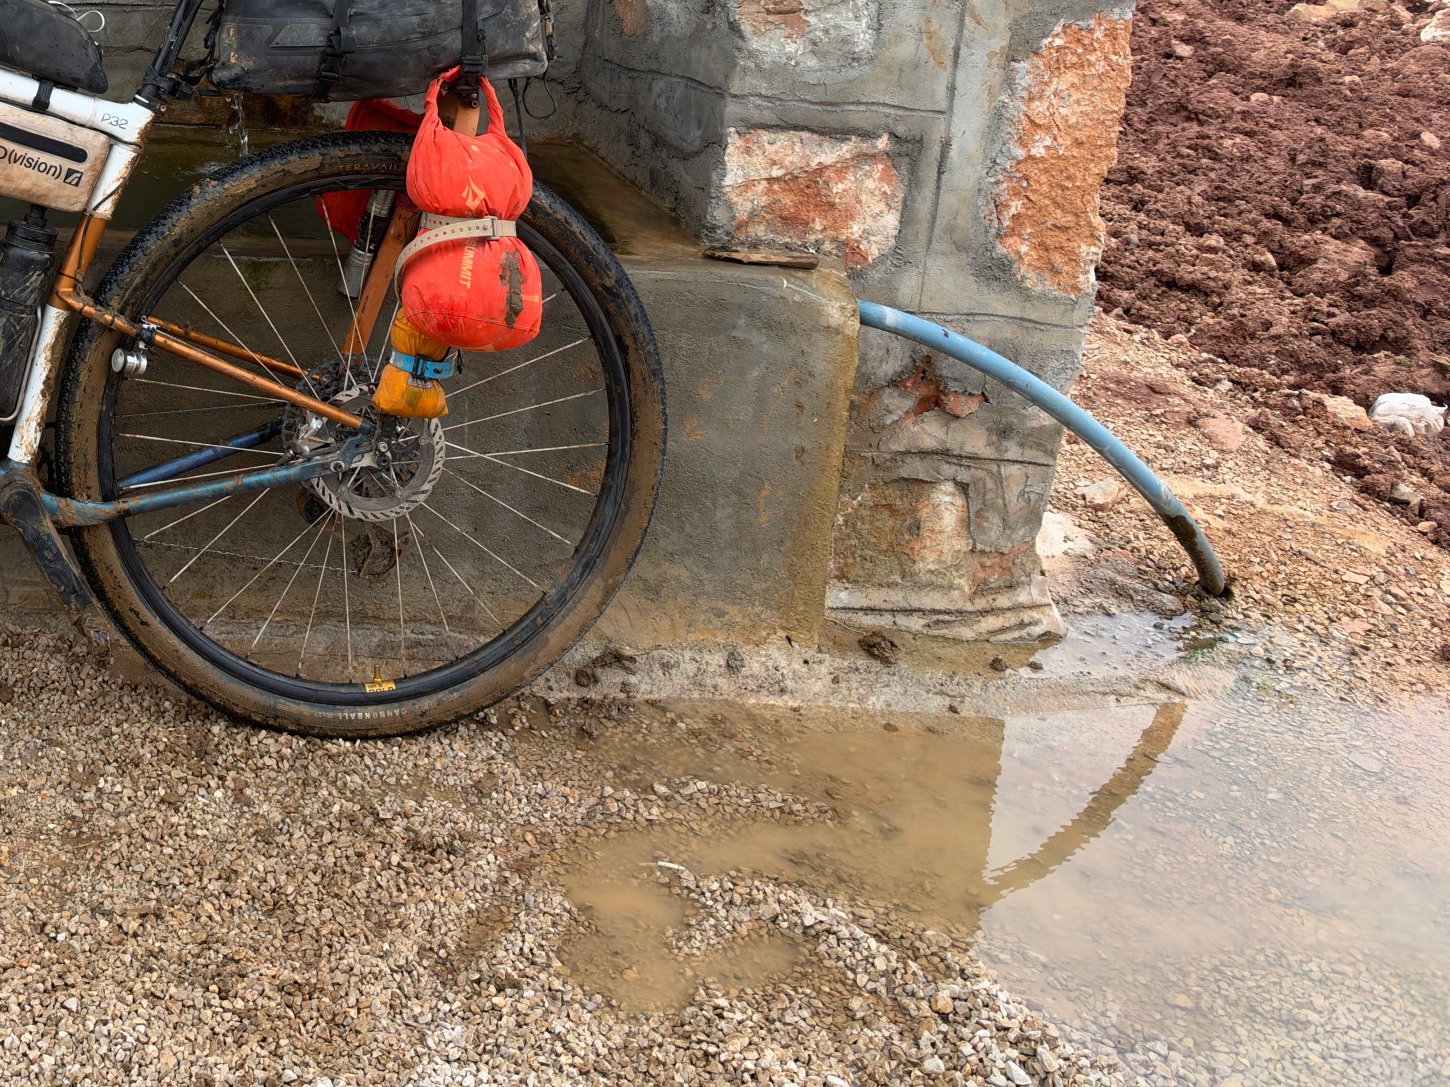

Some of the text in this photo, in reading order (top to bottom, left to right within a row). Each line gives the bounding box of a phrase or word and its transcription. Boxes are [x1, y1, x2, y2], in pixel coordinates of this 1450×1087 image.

[337, 163, 399, 172] TERAVAIL
[458, 236, 477, 290] SUMMIT
[337, 706, 408, 721] CANNONBALL
